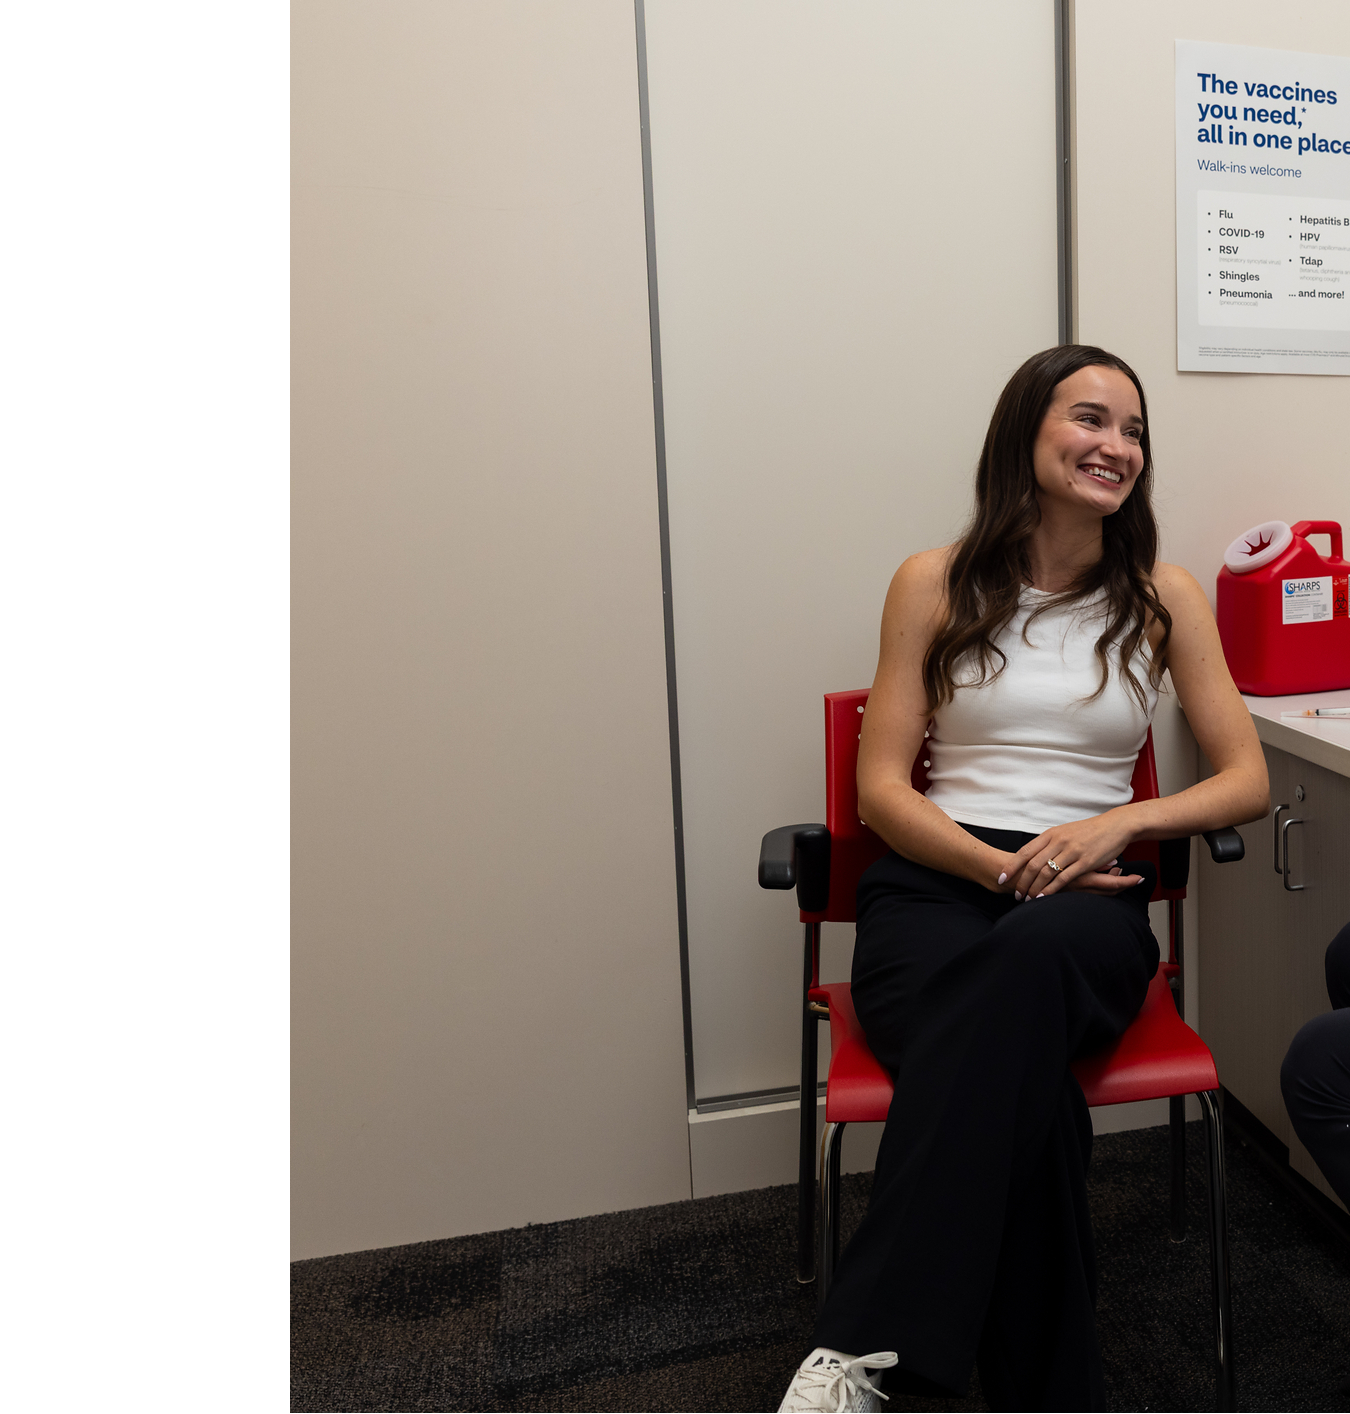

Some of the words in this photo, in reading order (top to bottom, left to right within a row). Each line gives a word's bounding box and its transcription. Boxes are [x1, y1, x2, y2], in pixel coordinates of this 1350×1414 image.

[1197, 73, 1238, 95] The
[1244, 82, 1338, 104] vaccines
[1198, 103, 1237, 123] you
[1197, 125, 1223, 144] all
[1229, 126, 1247, 145] in
[1253, 130, 1292, 149] one
[1197, 159, 1246, 174] Walk-ins
[1250, 163, 1302, 178] welcome
[1219, 210, 1233, 219] Flu
[1300, 215, 1341, 226] Hepatitis
[1344, 218, 1350, 226] B
[1219, 228, 1264, 238] COVID-19
[1300, 233, 1320, 241] HPV
[1219, 246, 1239, 254] RSV
[1300, 257, 1323, 267] Tdap
[1219, 271, 1260, 282] Shingles
[1220, 289, 1273, 299] Pneumonia
[1298, 289, 1316, 298] and
[1318, 291, 1344, 299] more!
[1289, 581, 1320, 591] SHARPS
